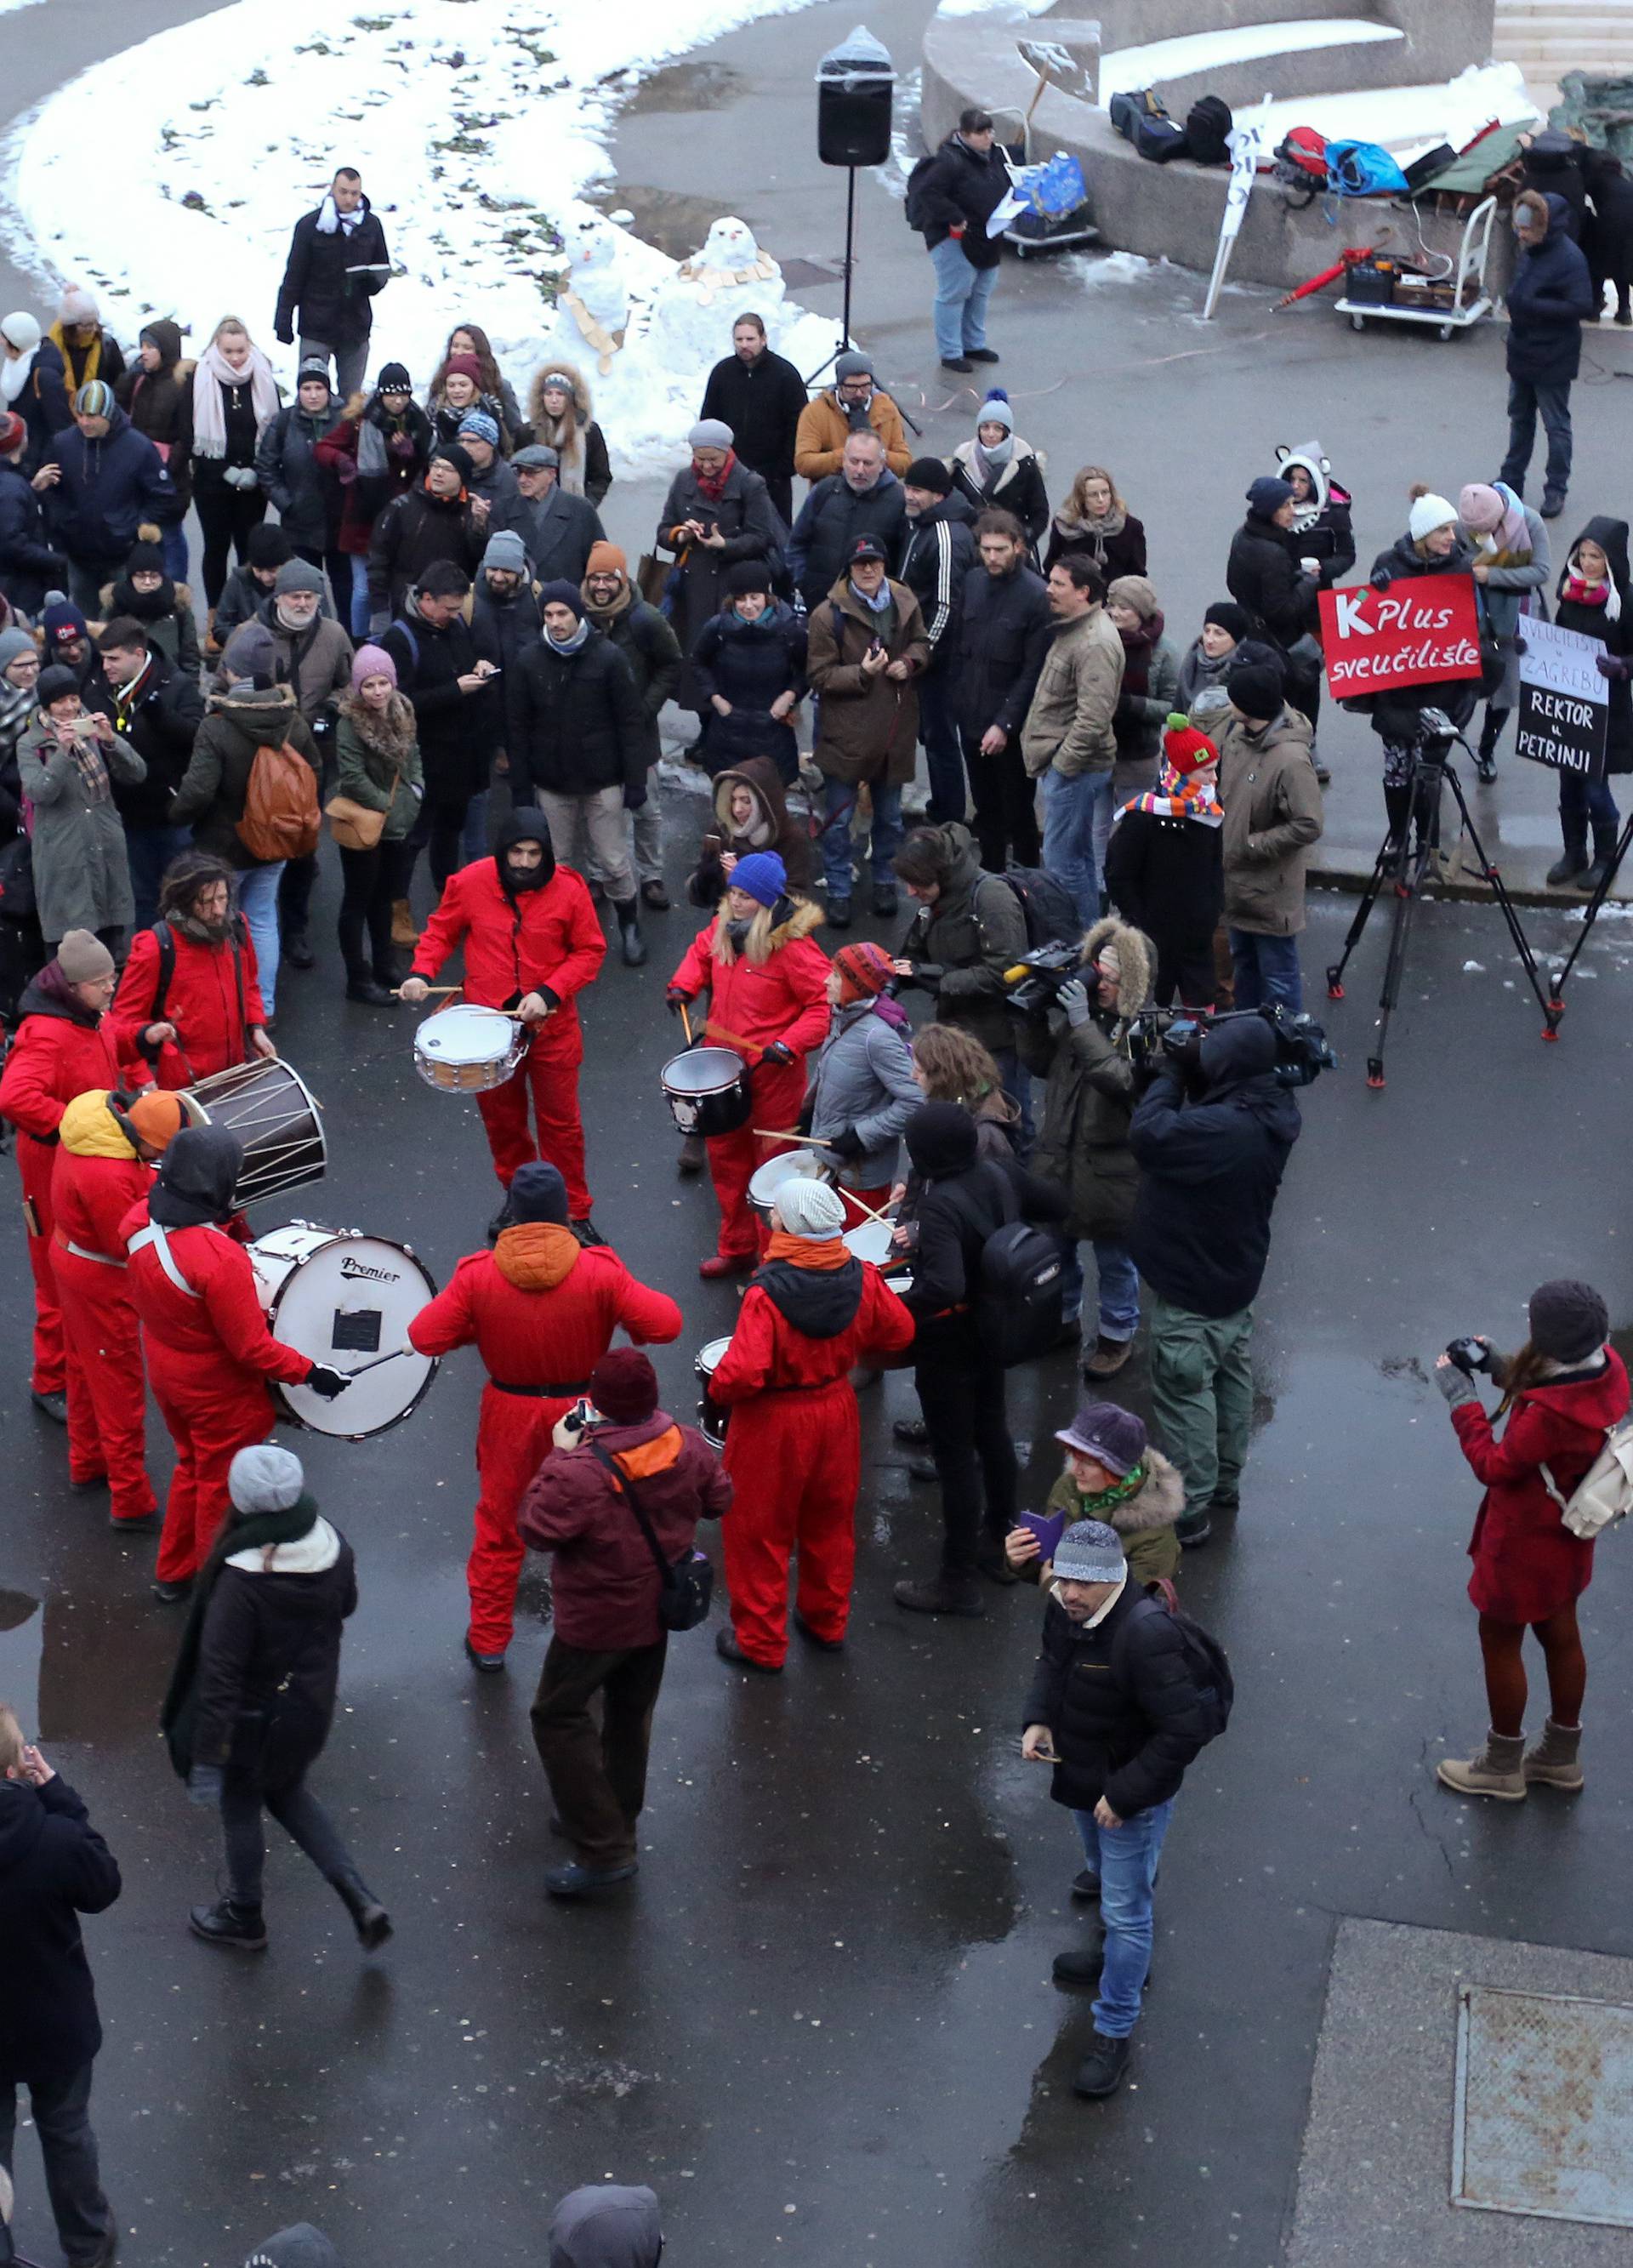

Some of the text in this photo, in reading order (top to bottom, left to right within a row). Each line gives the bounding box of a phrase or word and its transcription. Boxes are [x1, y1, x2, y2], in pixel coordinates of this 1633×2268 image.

[1336, 590, 1454, 639] K Plus
[1330, 638, 1478, 682] sveučilište
[1532, 691, 1593, 730] REKTOR
[1551, 724, 1562, 737] u
[1519, 731, 1590, 773] PETRINJI
[342, 1257, 401, 1282] Premier
